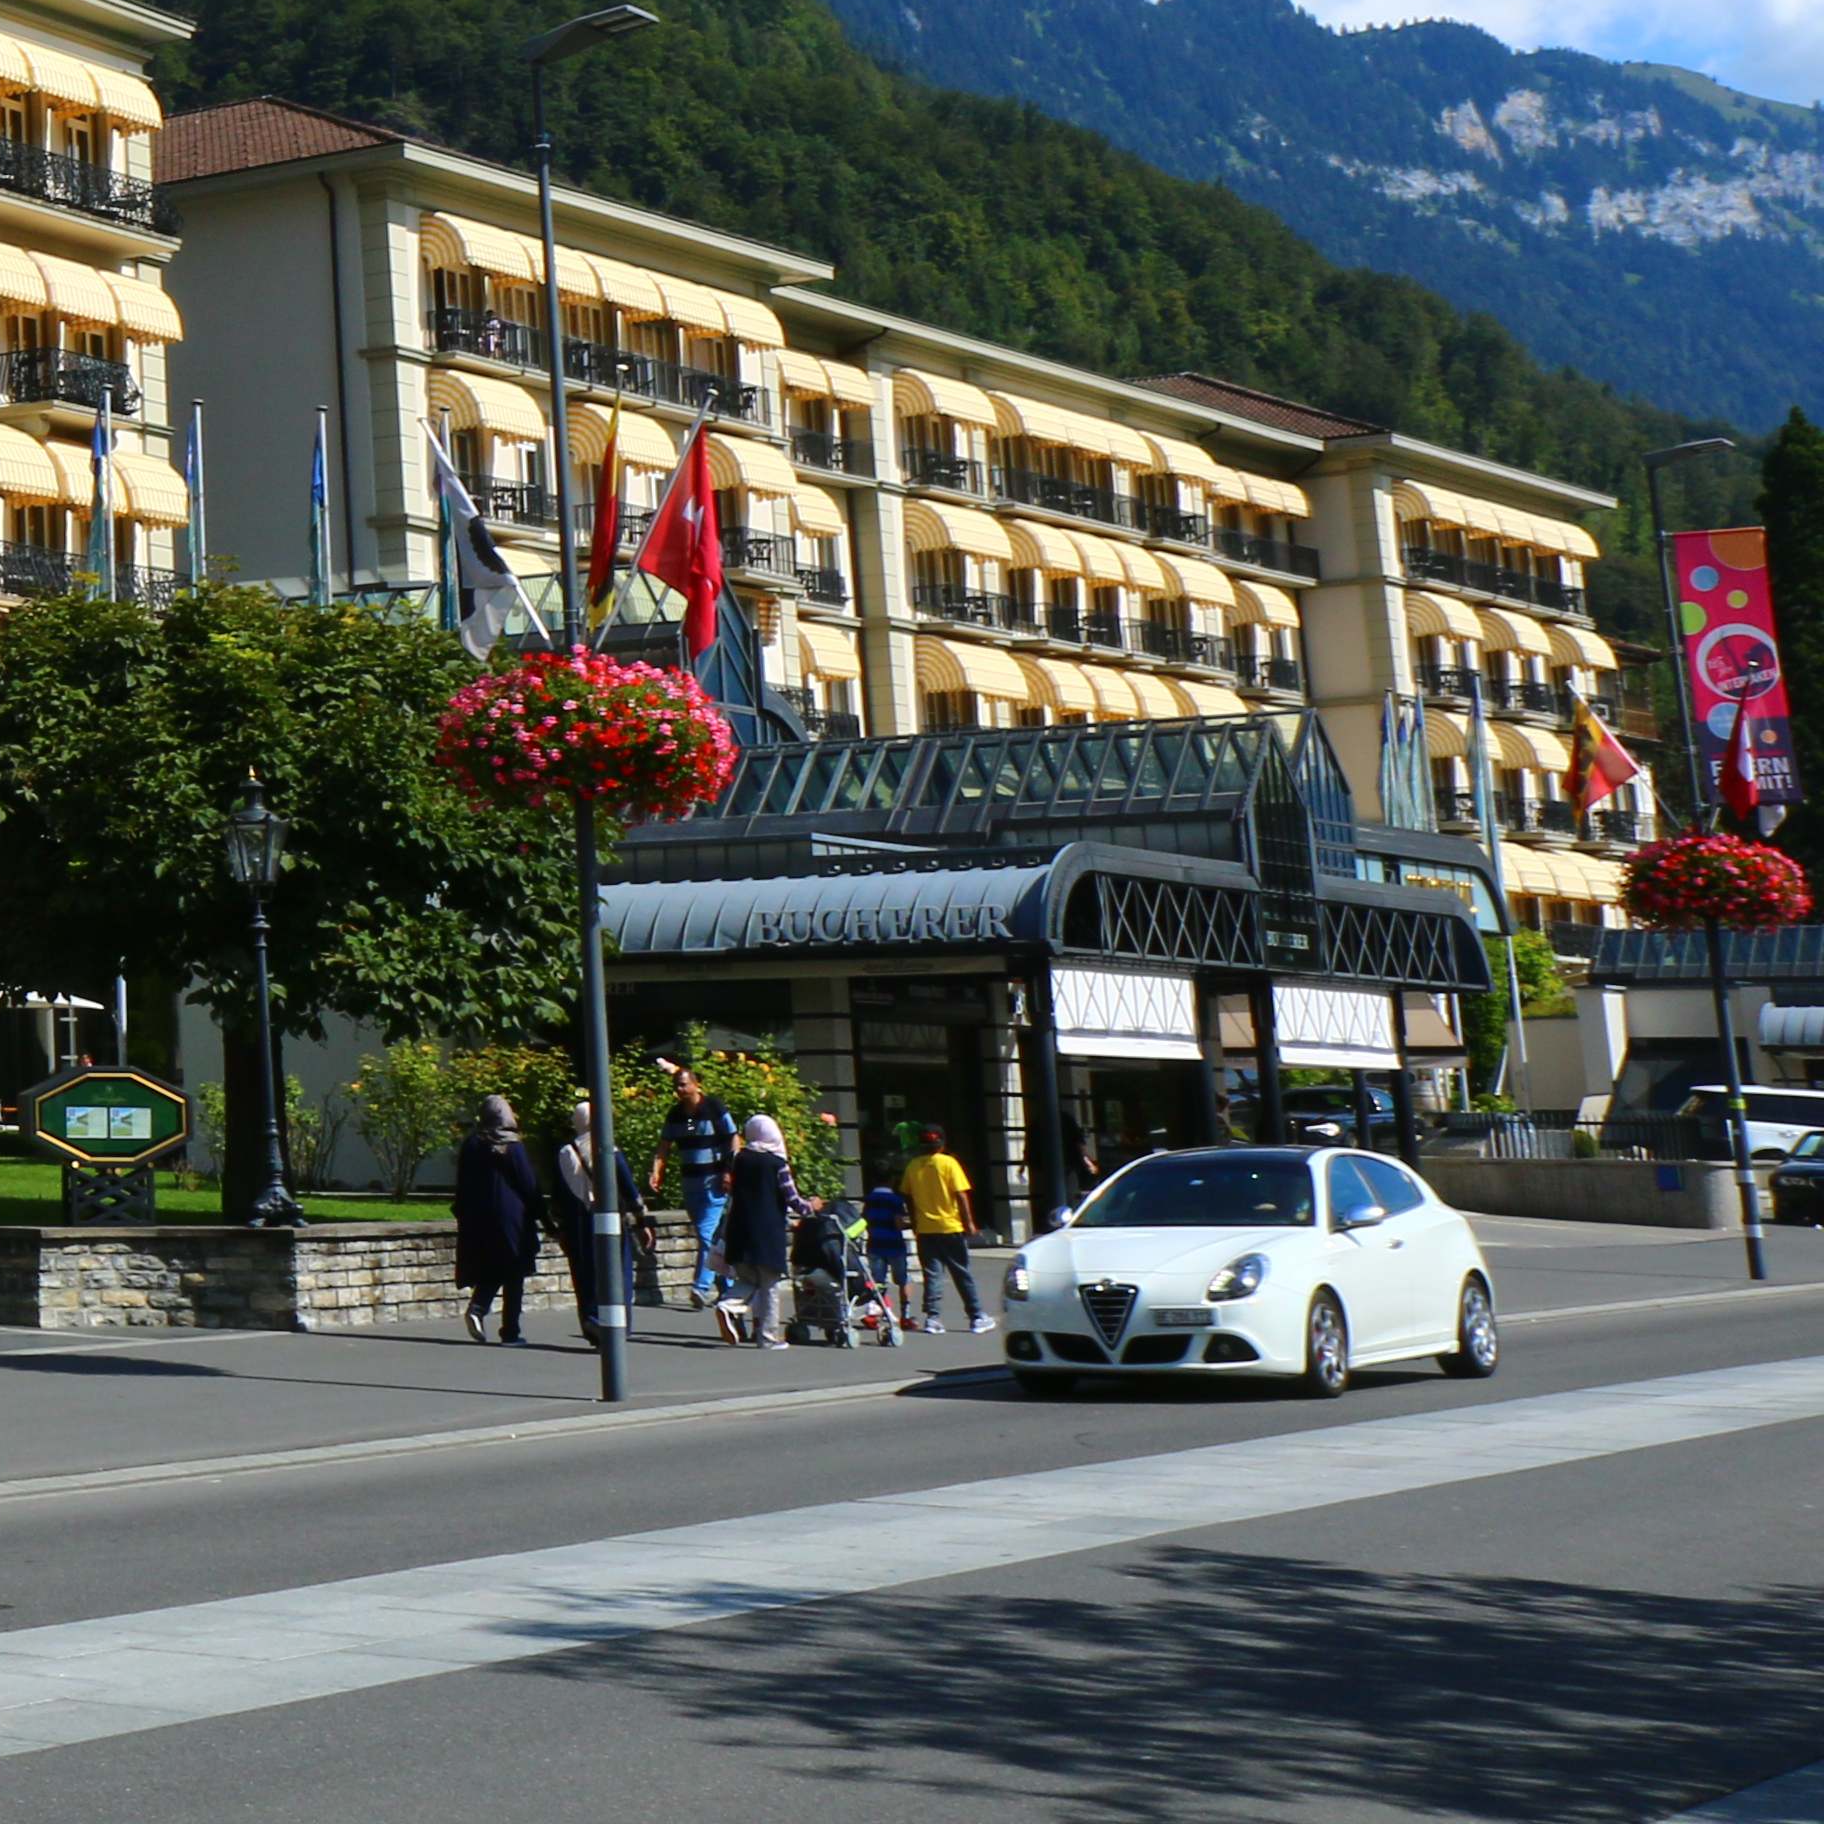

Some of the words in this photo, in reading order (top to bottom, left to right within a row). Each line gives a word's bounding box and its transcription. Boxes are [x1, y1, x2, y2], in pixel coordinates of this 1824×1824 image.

[1716, 667, 1777, 692] INTERAKEN
[754, 903, 1014, 944] BUCHERER
[1265, 929, 1310, 950] BUERER
